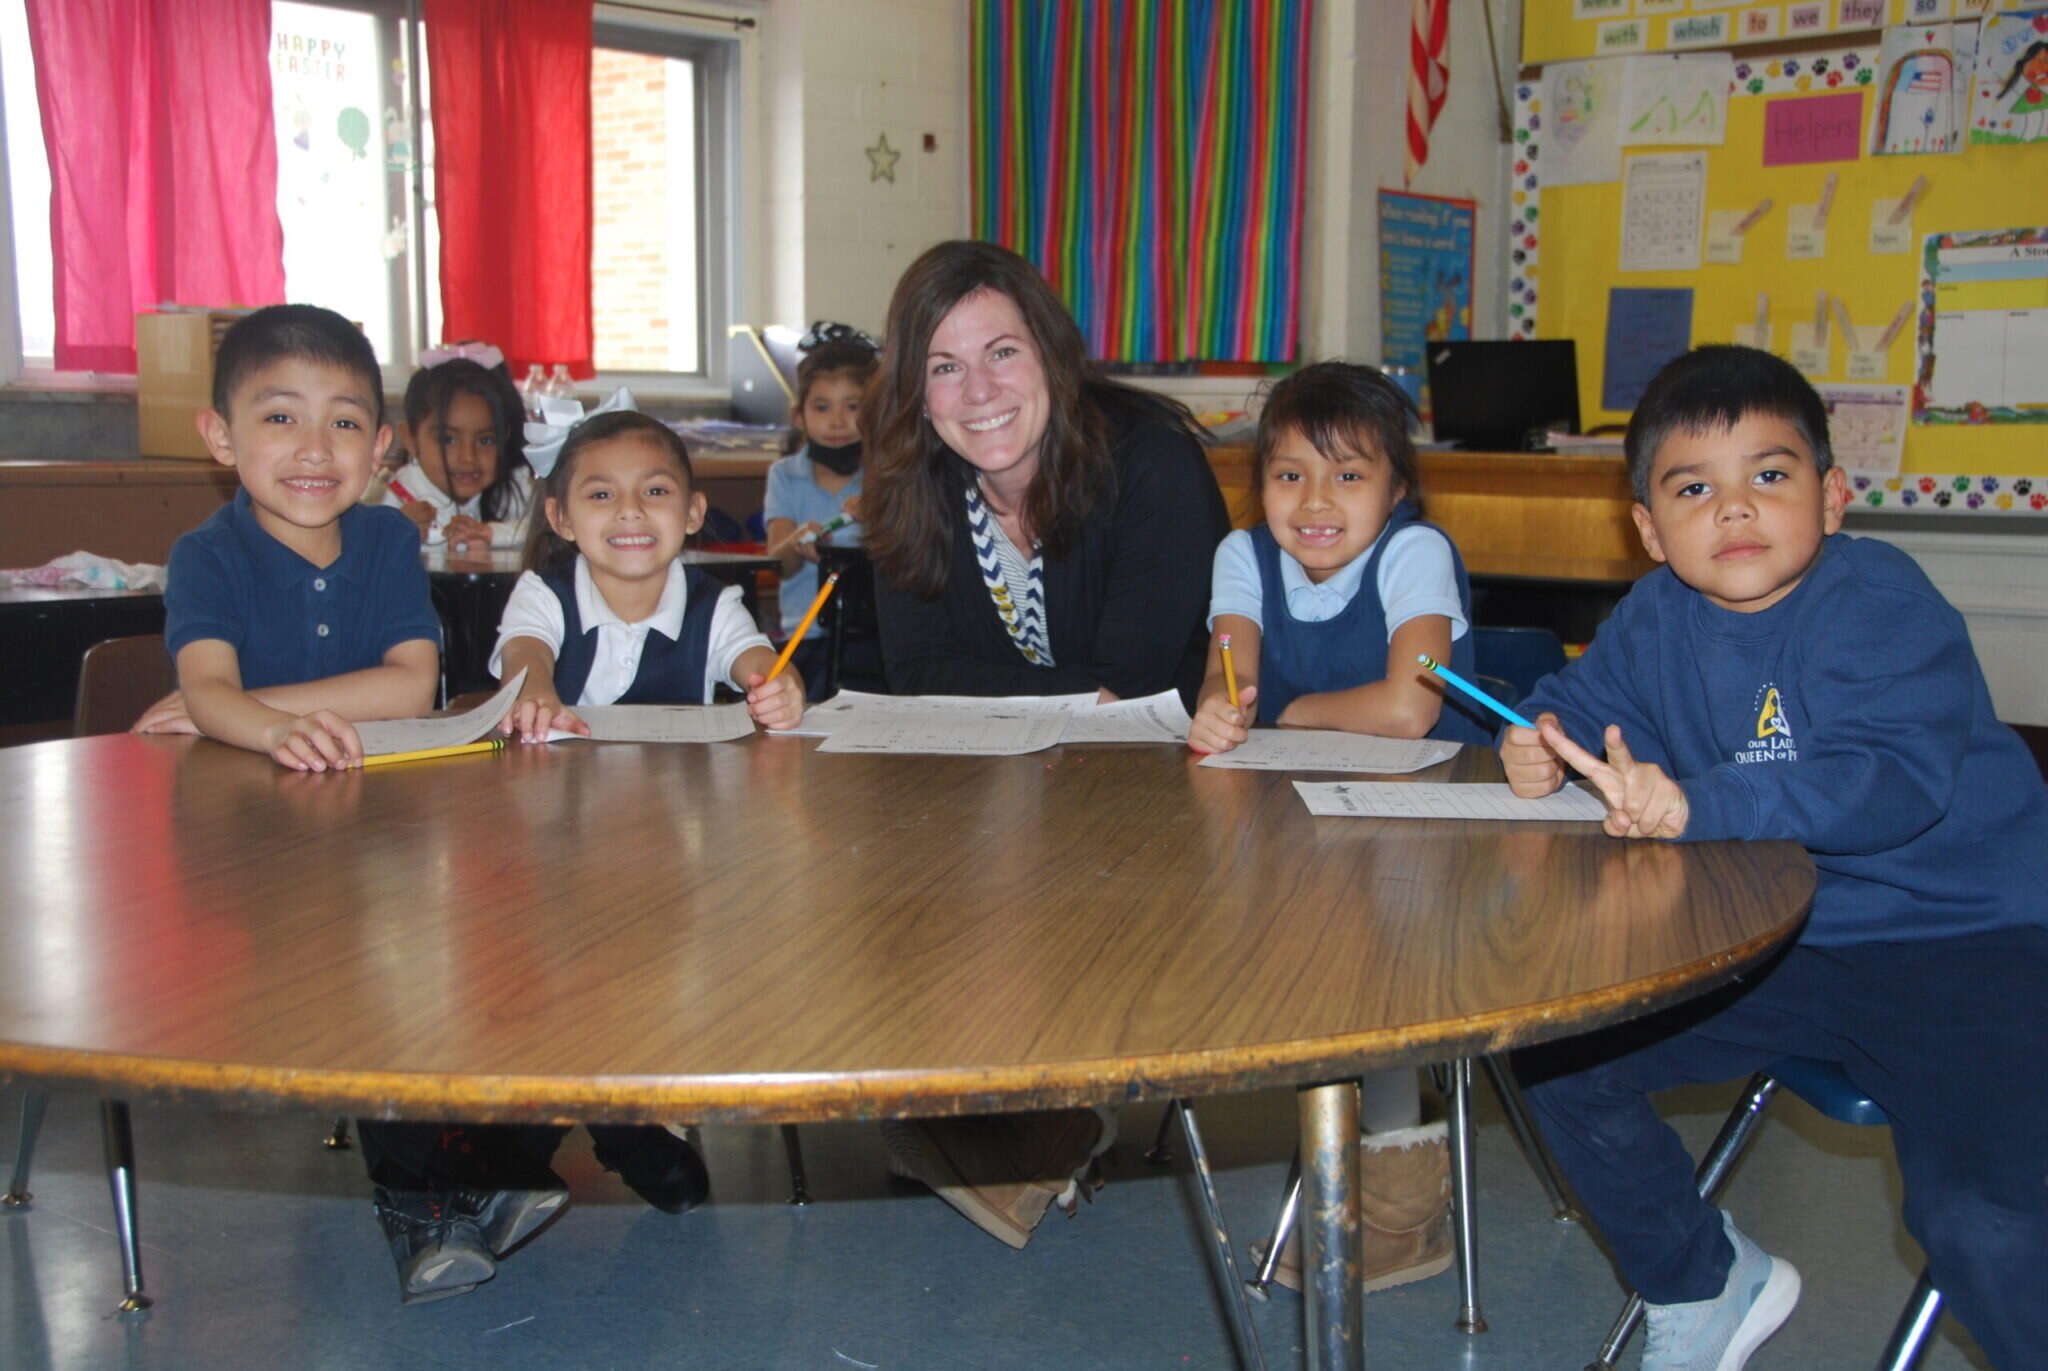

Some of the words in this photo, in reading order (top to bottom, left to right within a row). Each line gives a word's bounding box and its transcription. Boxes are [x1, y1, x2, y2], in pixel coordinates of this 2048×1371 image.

[1843, 4, 1882, 25] they
[1916, 0, 1936, 11] so
[1673, 14, 1721, 41] which
[1750, 13, 1767, 32] to
[1793, 13, 1819, 27] we
[1603, 24, 1640, 44] with
[276, 32, 345, 60] HAPPY
[276, 53, 345, 80] EASTER
[1774, 111, 1856, 153] Helpers
[2009, 247, 2020, 258] A
[1748, 740, 1768, 749] OUR
[1735, 750, 1775, 764] QUEEN
